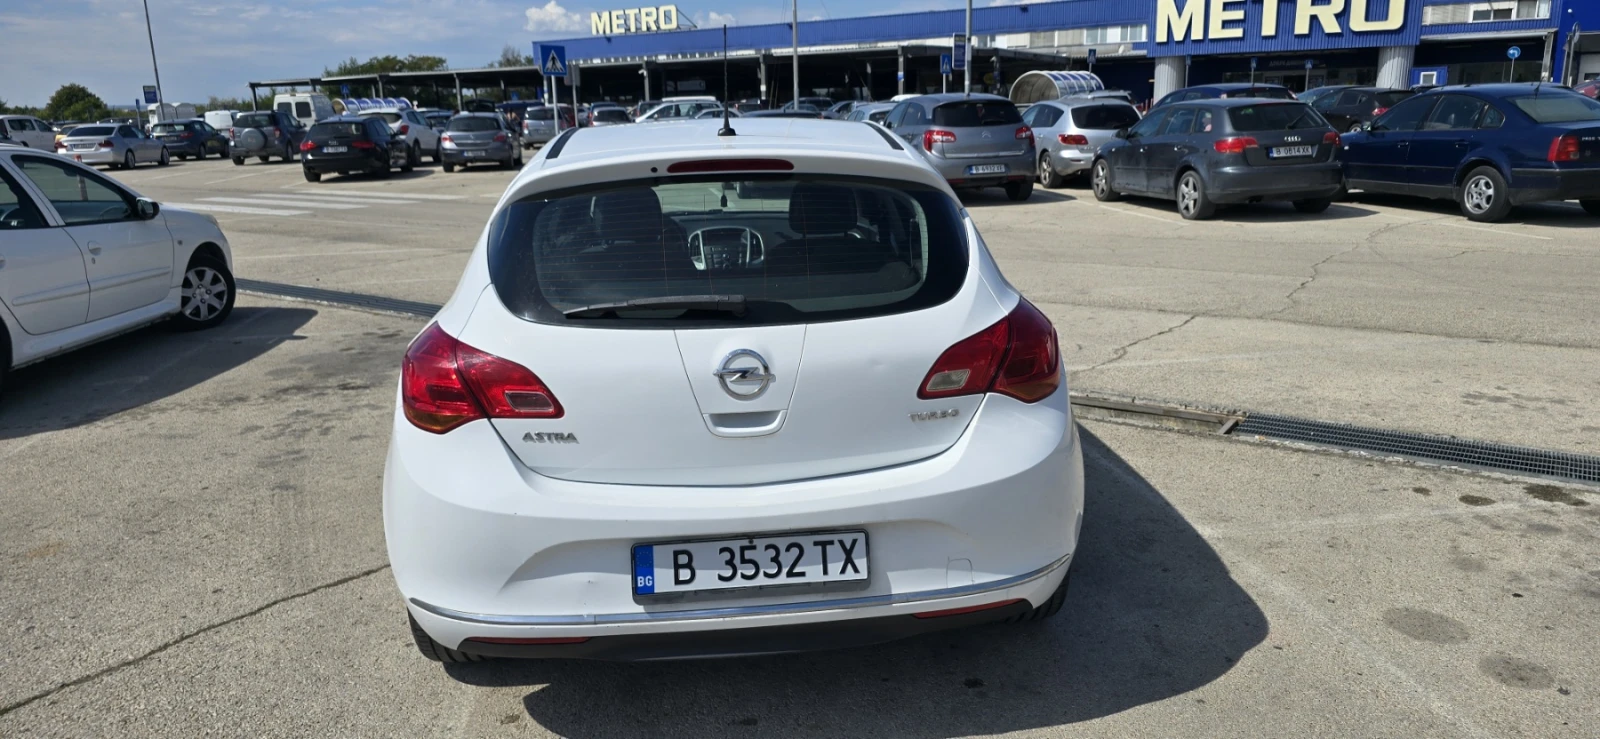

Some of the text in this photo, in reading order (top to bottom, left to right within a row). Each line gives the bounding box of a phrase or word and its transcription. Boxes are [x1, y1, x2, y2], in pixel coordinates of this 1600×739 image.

[591, 4, 678, 35] METRO
[1154, 0, 1407, 43] METRO
[908, 408, 960, 422] TURBO
[522, 431, 579, 444] ASTRA
[673, 538, 860, 586] B 3532 TX
[637, 576, 653, 587] BG
